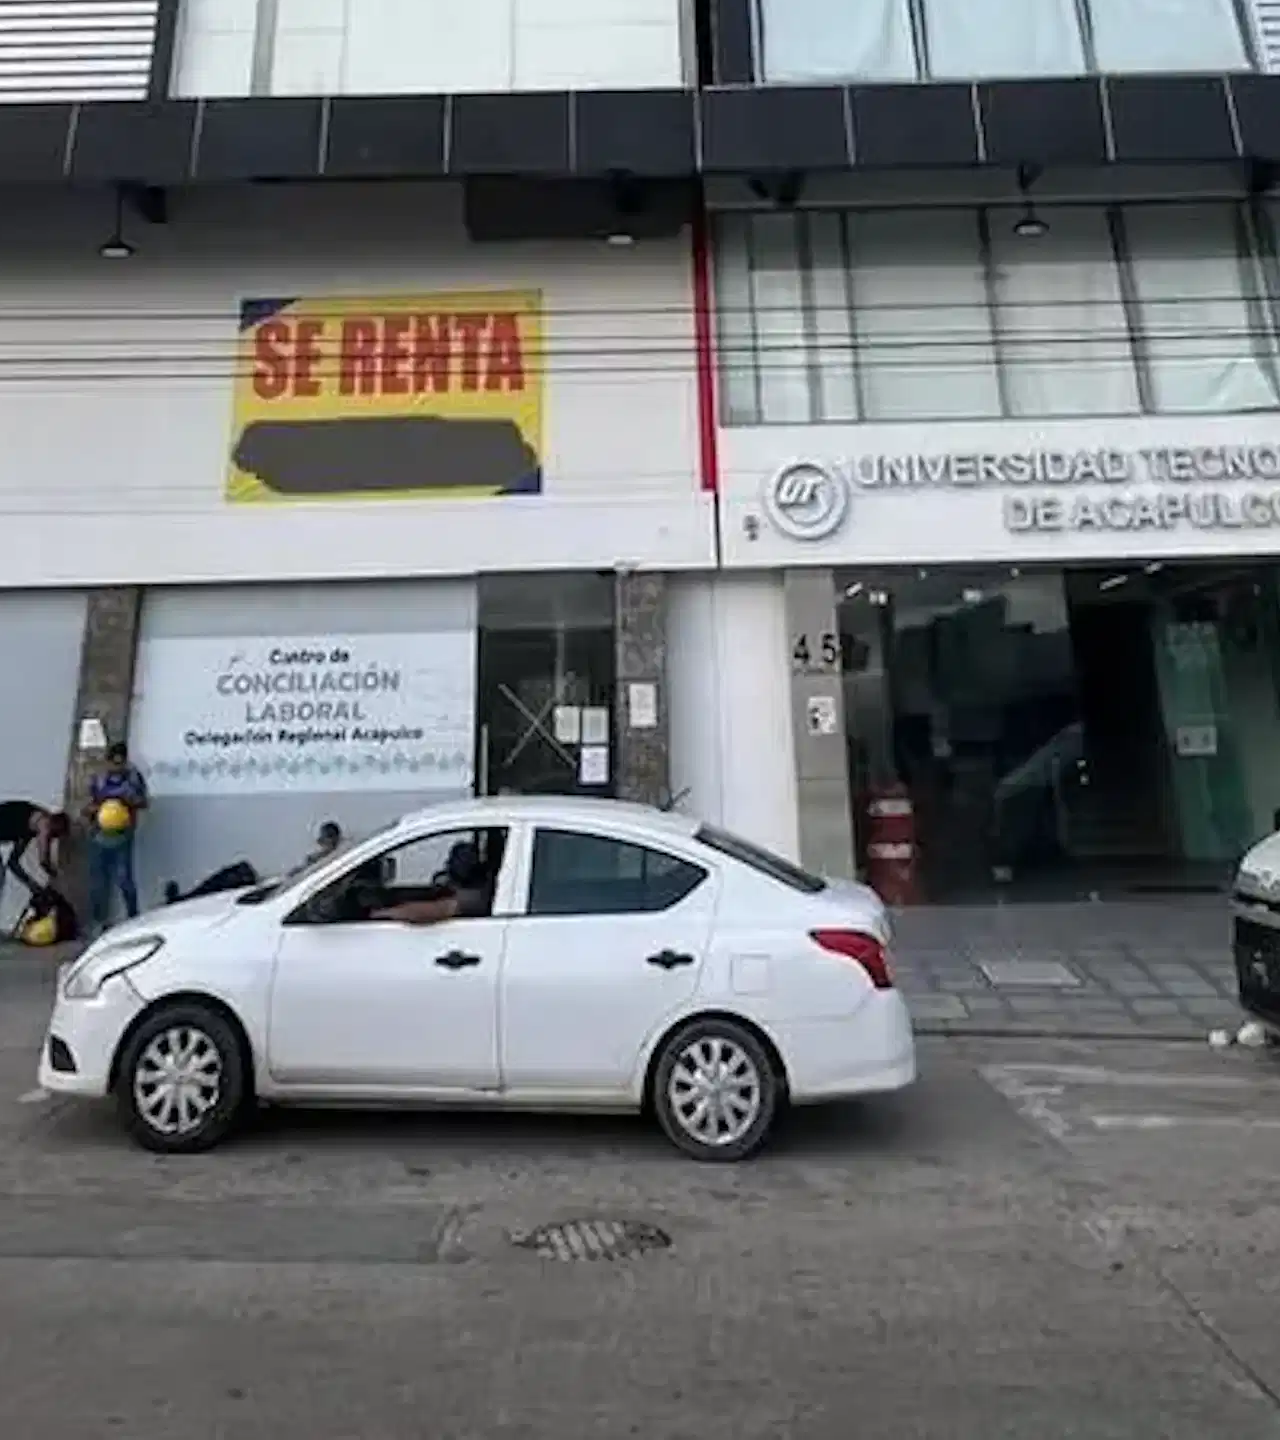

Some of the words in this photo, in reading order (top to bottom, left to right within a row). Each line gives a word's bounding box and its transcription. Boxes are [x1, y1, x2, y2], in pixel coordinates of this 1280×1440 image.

[253, 320, 324, 399] SE
[340, 313, 524, 396] RENTA
[853, 448, 1130, 487] UNIVERSIDAD
[1003, 495, 1063, 531] DE
[216, 661, 401, 695] CONCILIACIÓN
[245, 700, 368, 723] LABORAL
